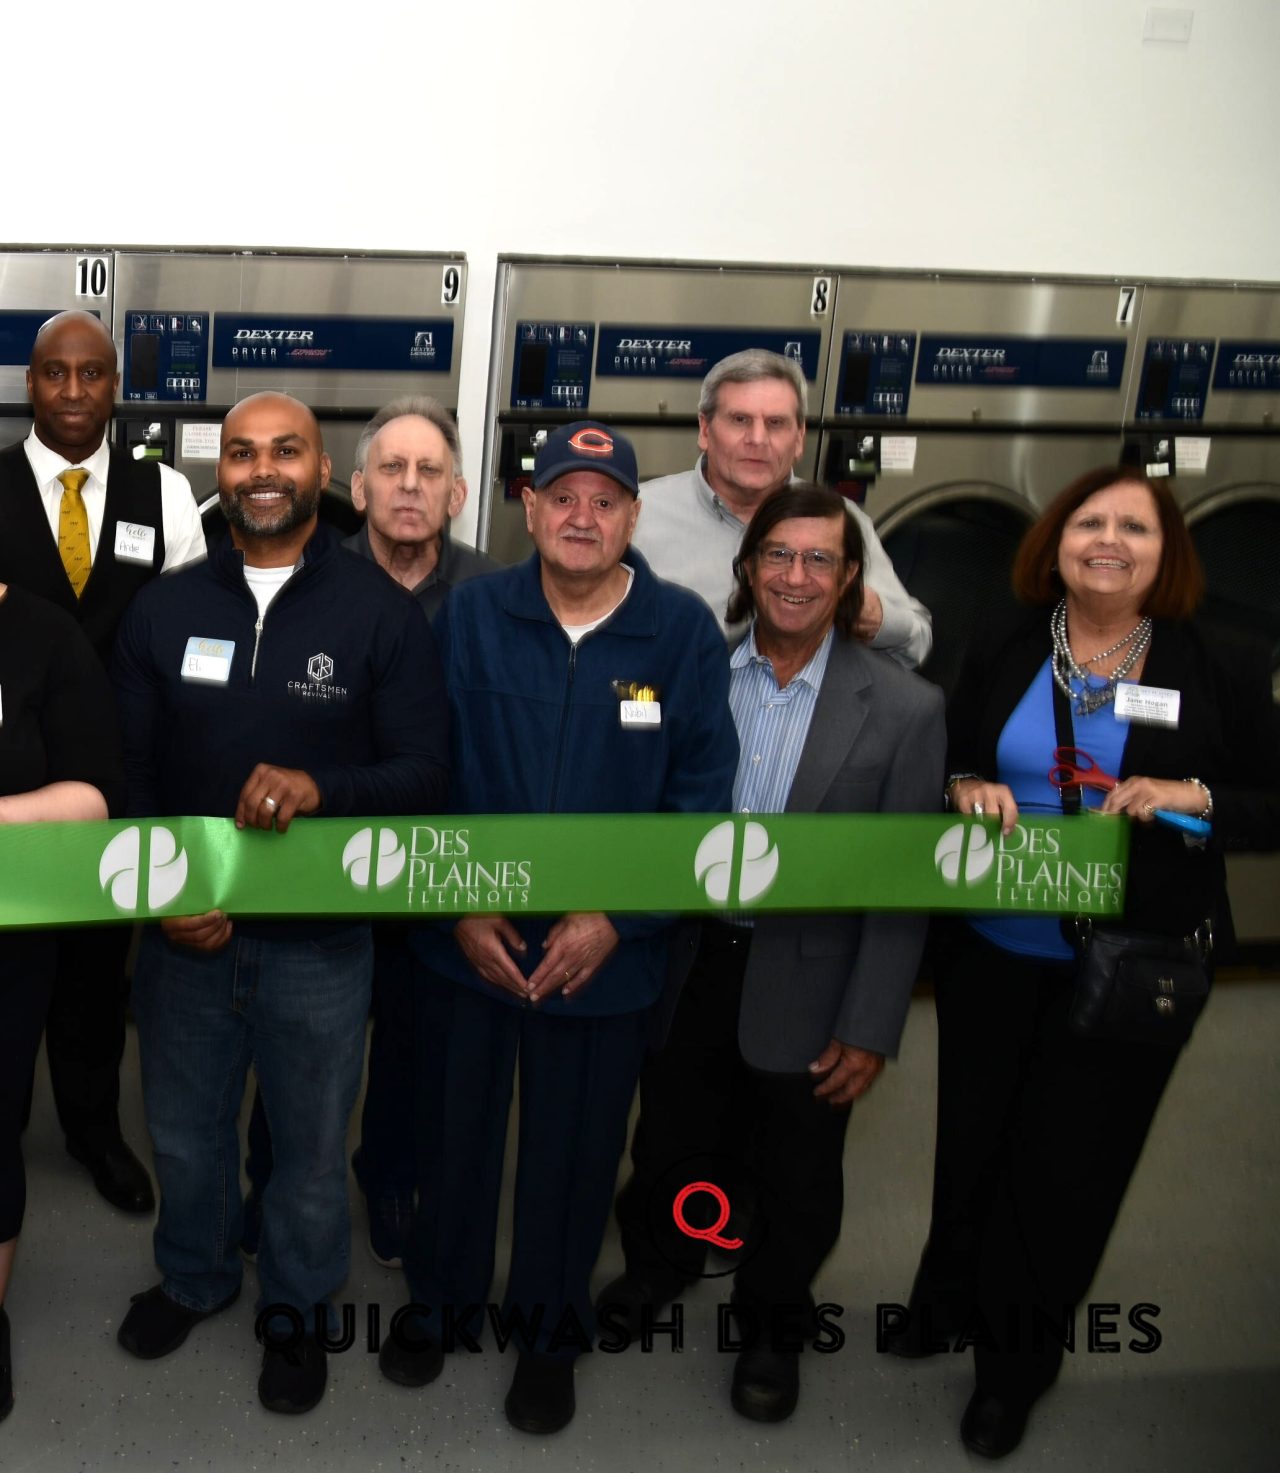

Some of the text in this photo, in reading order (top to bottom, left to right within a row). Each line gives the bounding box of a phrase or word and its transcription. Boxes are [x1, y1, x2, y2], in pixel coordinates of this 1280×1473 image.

[78, 258, 107, 296] 10
[444, 267, 459, 302] 9
[813, 279, 828, 313] 8
[1121, 287, 1135, 321] 7
[233, 329, 314, 340] DEXTER
[232, 347, 277, 355] DRYER
[617, 338, 692, 350] DEXTER
[614, 356, 656, 364] DRYER
[936, 347, 1006, 359] DEXTER
[933, 364, 972, 373] DRYER
[126, 523, 147, 537] hello
[287, 680, 347, 695] CRAFTSMEN
[302, 691, 331, 699] REVIVAL
[410, 826, 469, 857] DES
[998, 823, 1061, 854] DES
[407, 858, 531, 888] PLAINES
[996, 854, 1123, 889] PLAINES
[407, 890, 529, 904] ILLINOIS
[996, 888, 1120, 904] ILLINOIS
